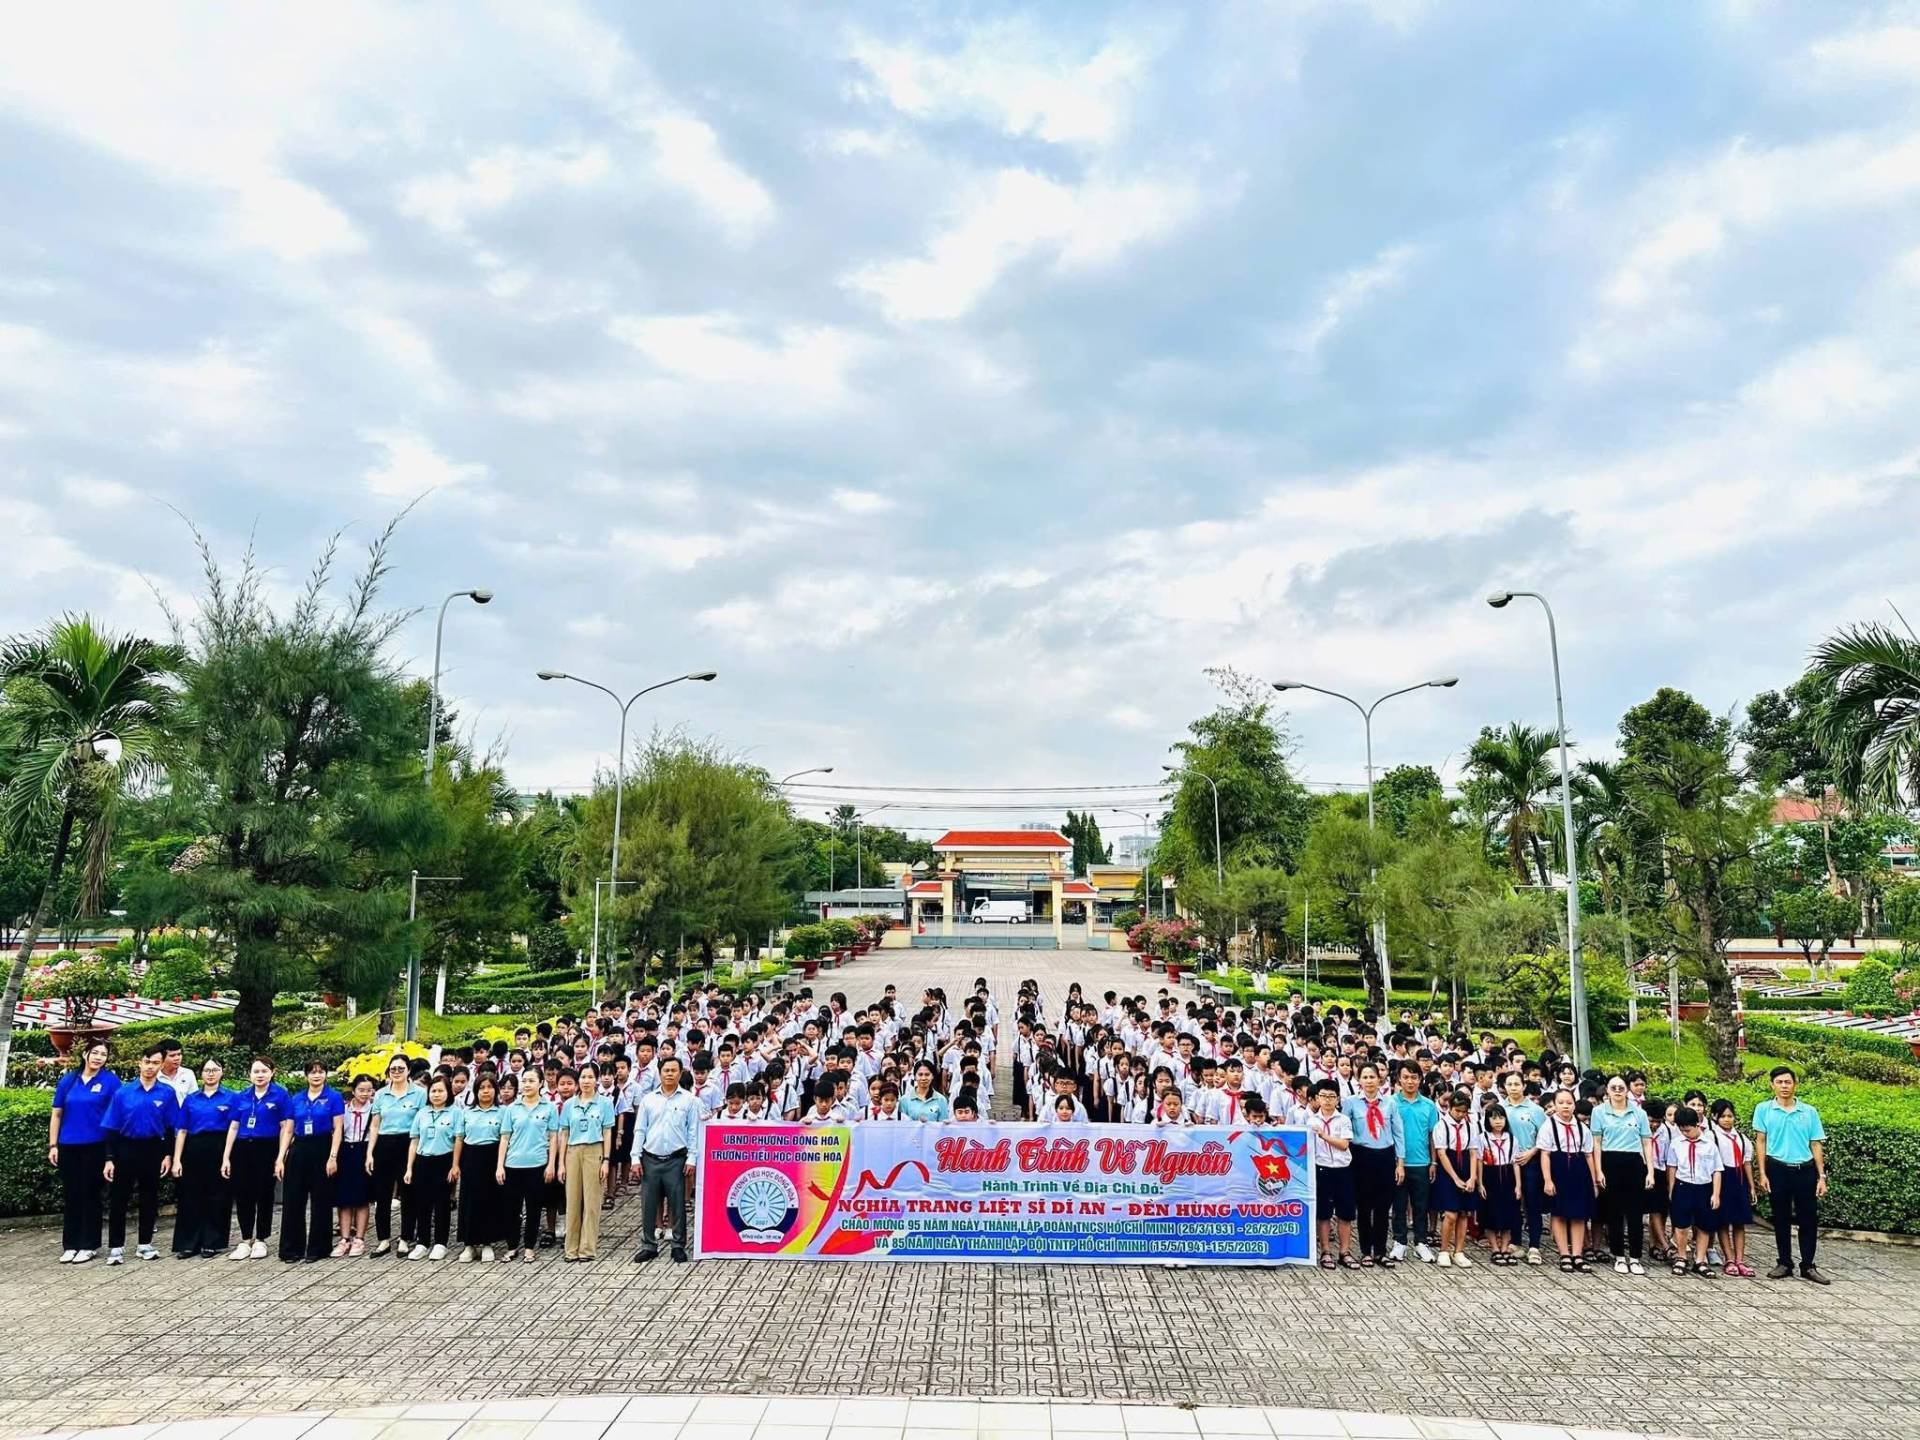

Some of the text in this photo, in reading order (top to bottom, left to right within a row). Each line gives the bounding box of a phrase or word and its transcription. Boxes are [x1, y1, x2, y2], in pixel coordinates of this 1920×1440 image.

[723, 1134, 749, 1145] UBND
[935, 1137, 1233, 1184] Hành Trình Về Nguồn
[982, 1179, 1018, 1192] Hành
[1022, 1179, 1058, 1192] Trình
[1062, 1178, 1080, 1193] Về
[1084, 1181, 1108, 1195] Địa
[1112, 1181, 1136, 1194] Chỉ
[838, 1197, 900, 1213] NGHĨA
[906, 1200, 973, 1213] TRANG
[978, 1198, 1022, 1216] LIỆT
[1028, 1198, 1046, 1214] SĨ
[1051, 1198, 1074, 1215] DĨ
[1078, 1201, 1106, 1215] AN
[1128, 1199, 1170, 1216] ĐỀN
[1175, 1201, 1231, 1217] HÙNG
[1236, 1202, 1303, 1218] VƯƠNG
[841, 1217, 870, 1230] CHÀO
[873, 1216, 905, 1231] MỪNG
[908, 1220, 921, 1231] 95
[923, 1217, 948, 1231] NĂM
[952, 1217, 980, 1231] NGÀY
[983, 1217, 1018, 1232] THÀNH
[1021, 1218, 1041, 1234] LẬP
[1044, 1218, 1074, 1233] ĐOÀN
[1075, 1220, 1103, 1233] TNCS
[1125, 1220, 1143, 1234] CHÍ
[1146, 1222, 1175, 1235] MINH
[1178, 1222, 1235, 1236] (26/3/1931
[1245, 1222, 1299, 1236] 26/3/2026)
[875, 1236, 890, 1249] VÀ
[892, 1237, 905, 1249] 85
[908, 1236, 933, 1250] NĂM
[935, 1236, 964, 1250] NGÀY
[968, 1236, 1002, 1250] THÀNH
[1005, 1236, 1026, 1253] LẬP
[1030, 1236, 1047, 1253] ĐỘI
[1050, 1239, 1077, 1251] TNTP
[1097, 1238, 1115, 1251] CHÍ
[1118, 1240, 1147, 1252] MINH
